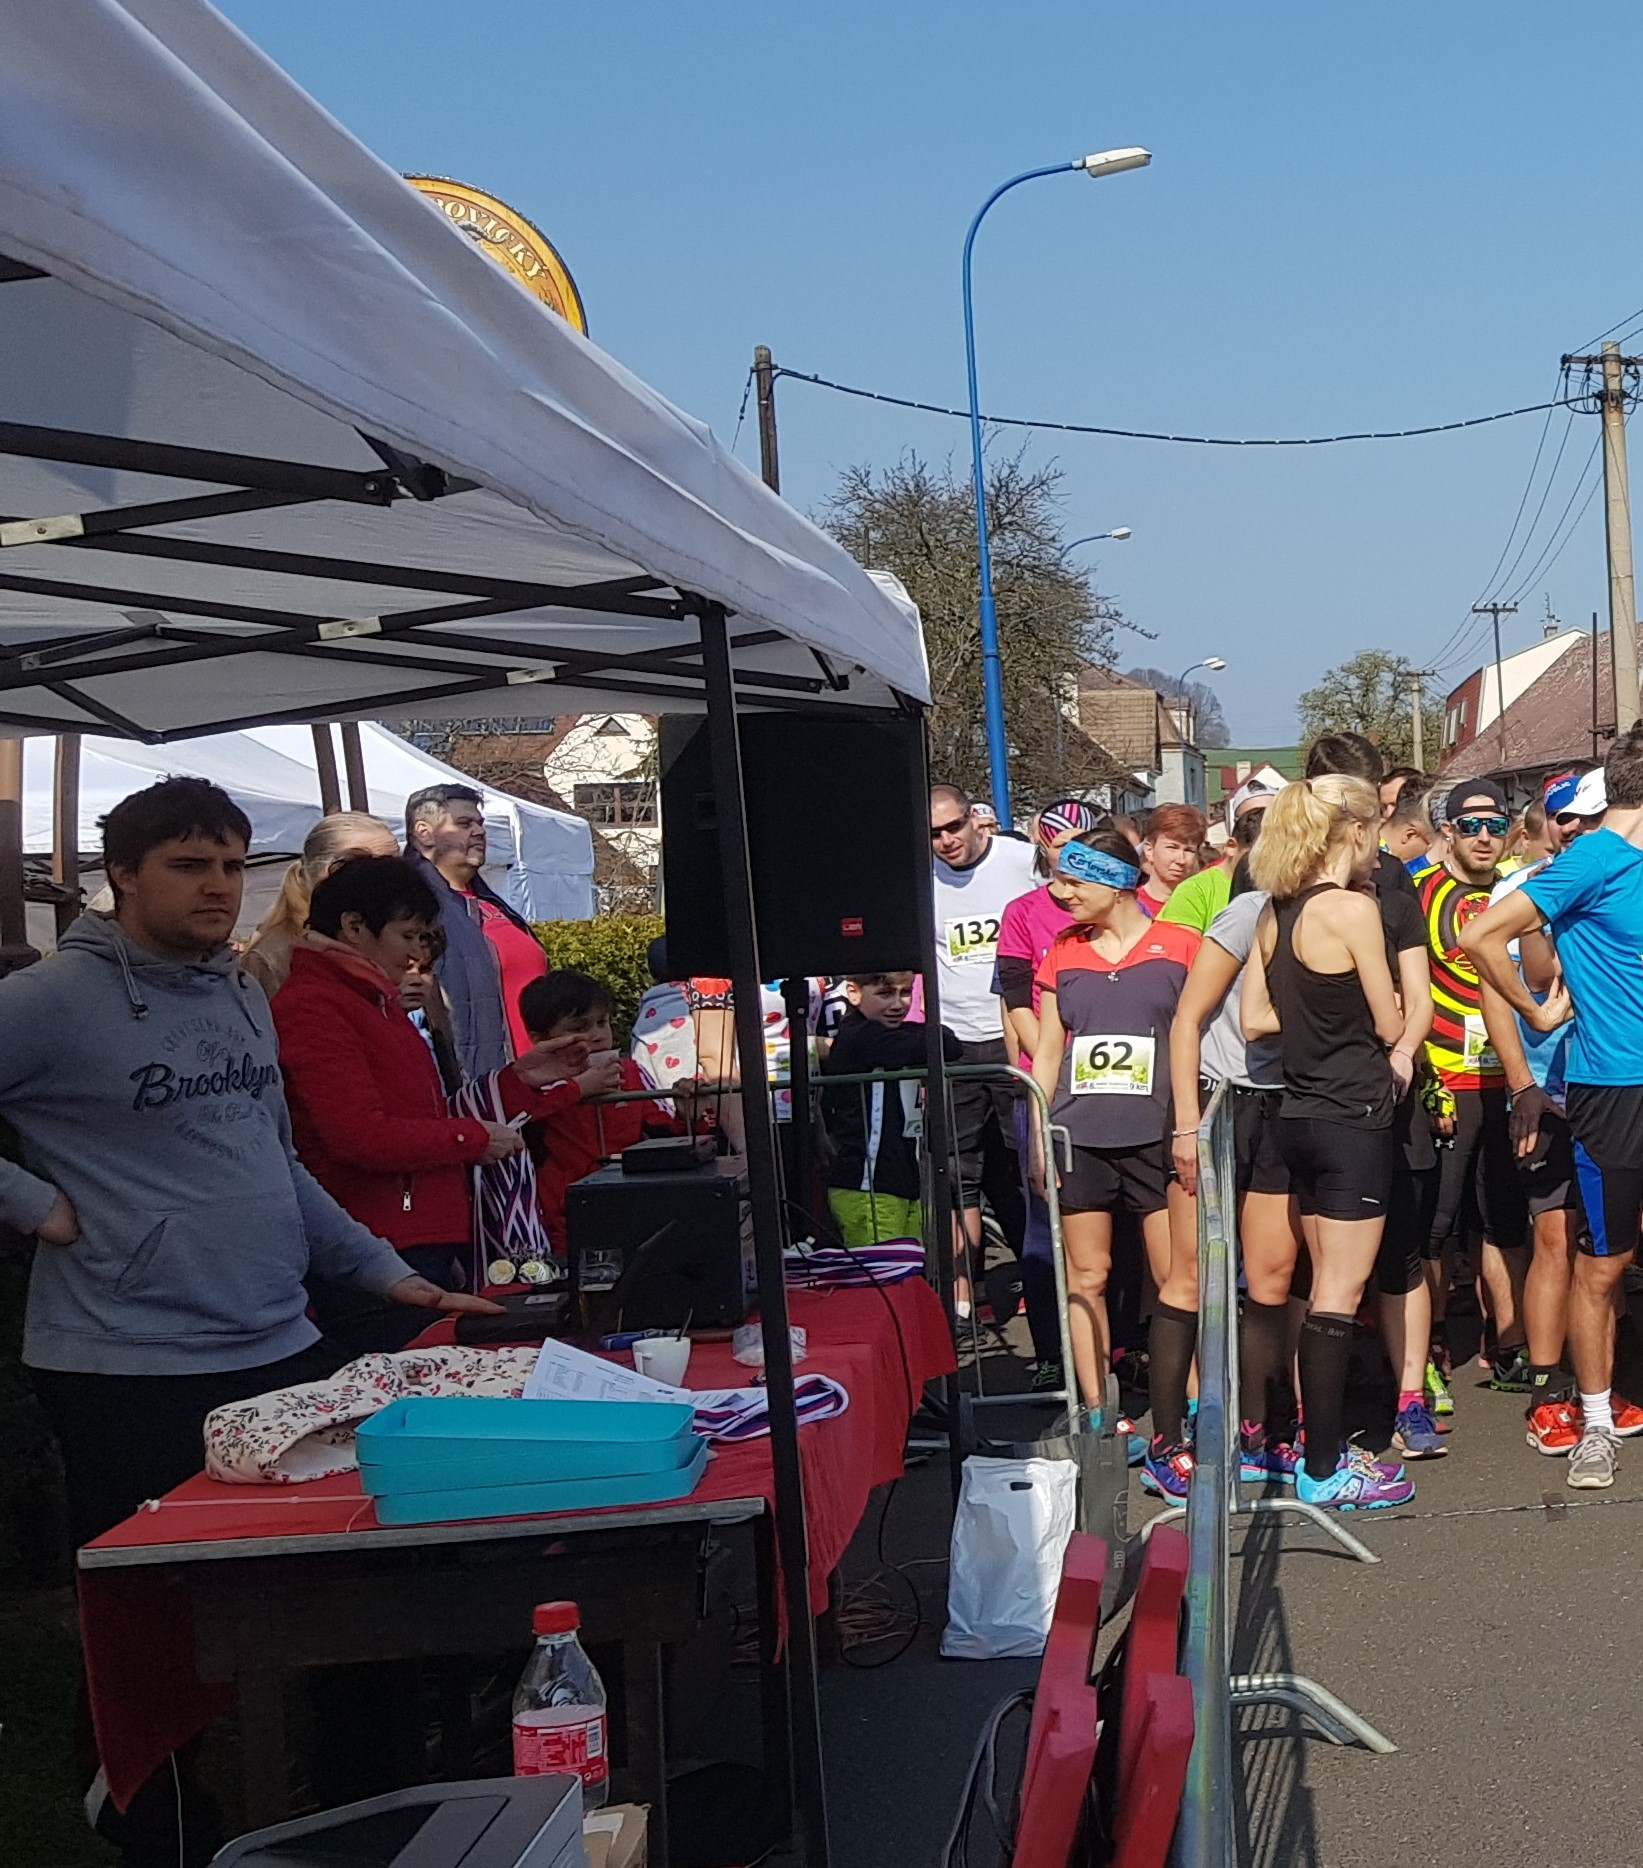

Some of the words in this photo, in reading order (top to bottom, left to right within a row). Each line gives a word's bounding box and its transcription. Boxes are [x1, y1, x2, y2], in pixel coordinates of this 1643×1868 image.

[953, 918, 1001, 946] 132
[1089, 1041, 1133, 1071] 62
[129, 1052, 278, 1111] Brooklyn
